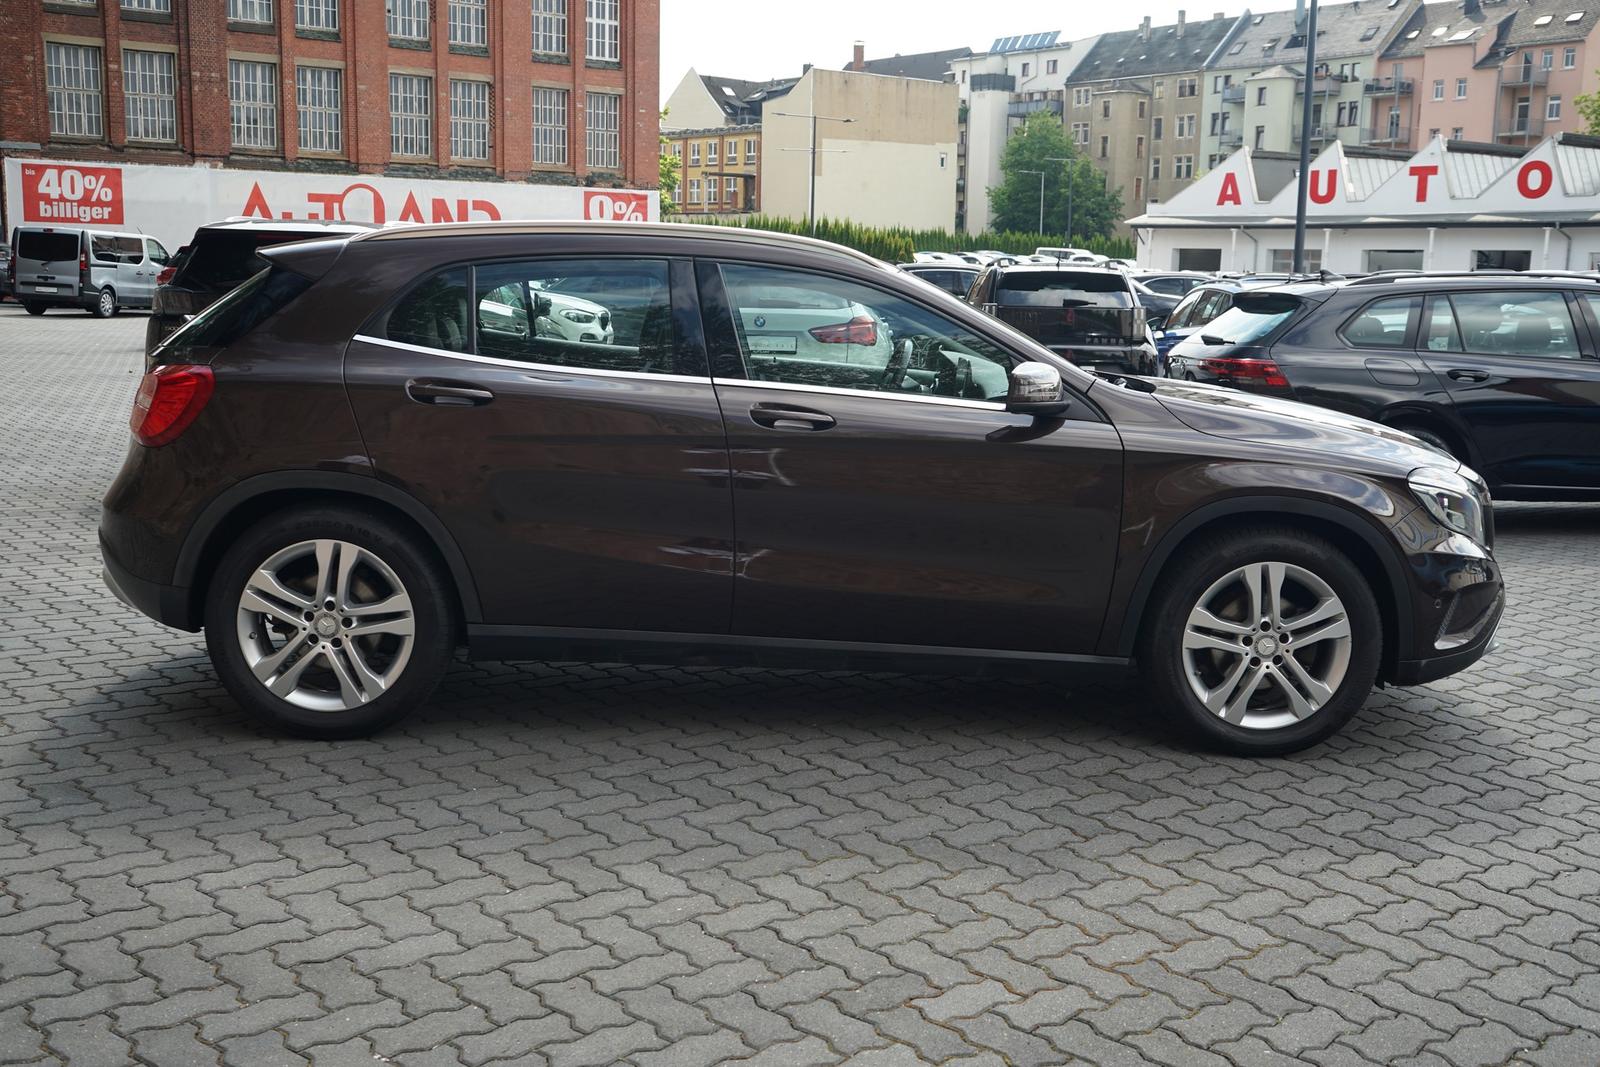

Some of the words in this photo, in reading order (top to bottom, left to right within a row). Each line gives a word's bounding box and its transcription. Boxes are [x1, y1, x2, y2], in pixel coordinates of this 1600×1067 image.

[25, 168, 36, 176] bis
[38, 168, 113, 202] 40%
[39, 201, 112, 222] billiger
[589, 194, 644, 222] 0%
